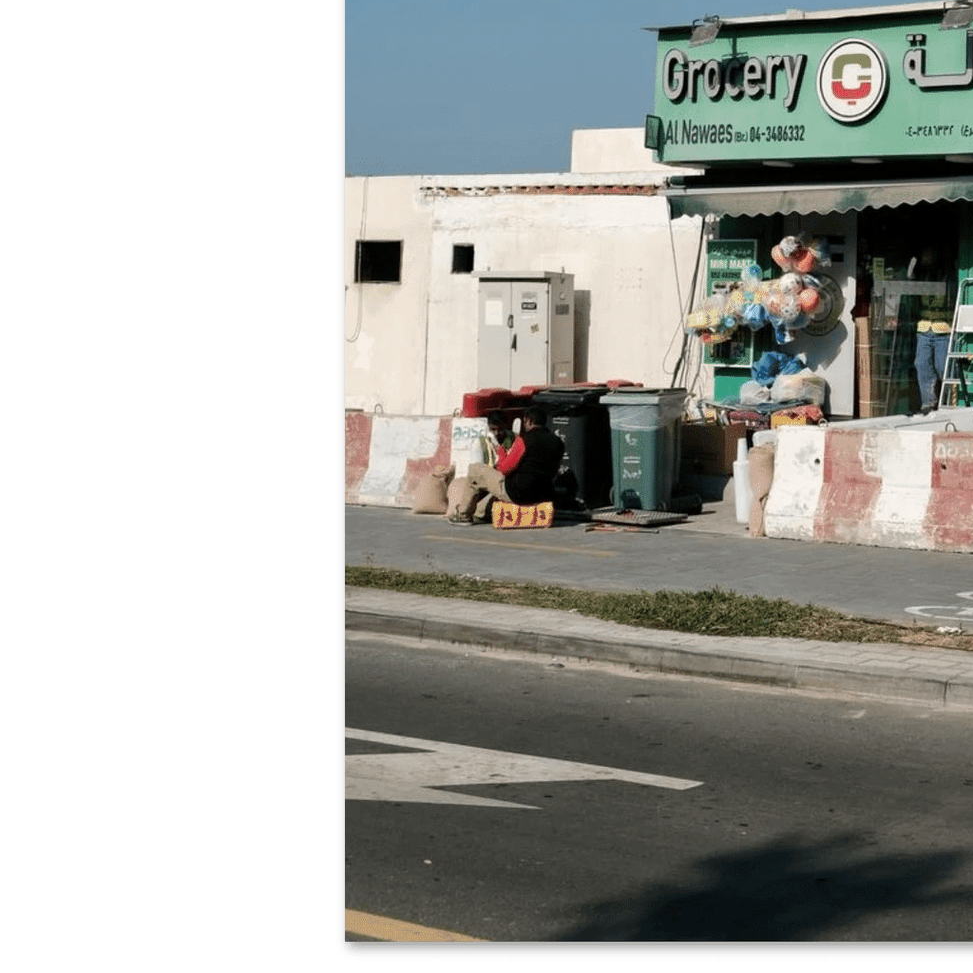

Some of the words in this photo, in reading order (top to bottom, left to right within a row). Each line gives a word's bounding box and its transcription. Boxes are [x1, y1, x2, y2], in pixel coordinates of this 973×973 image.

[663, 48, 806, 109] Grocery
[665, 119, 678, 145] Al
[681, 119, 733, 145] Nawaes
[749, 124, 806, 143] 04-3486332
